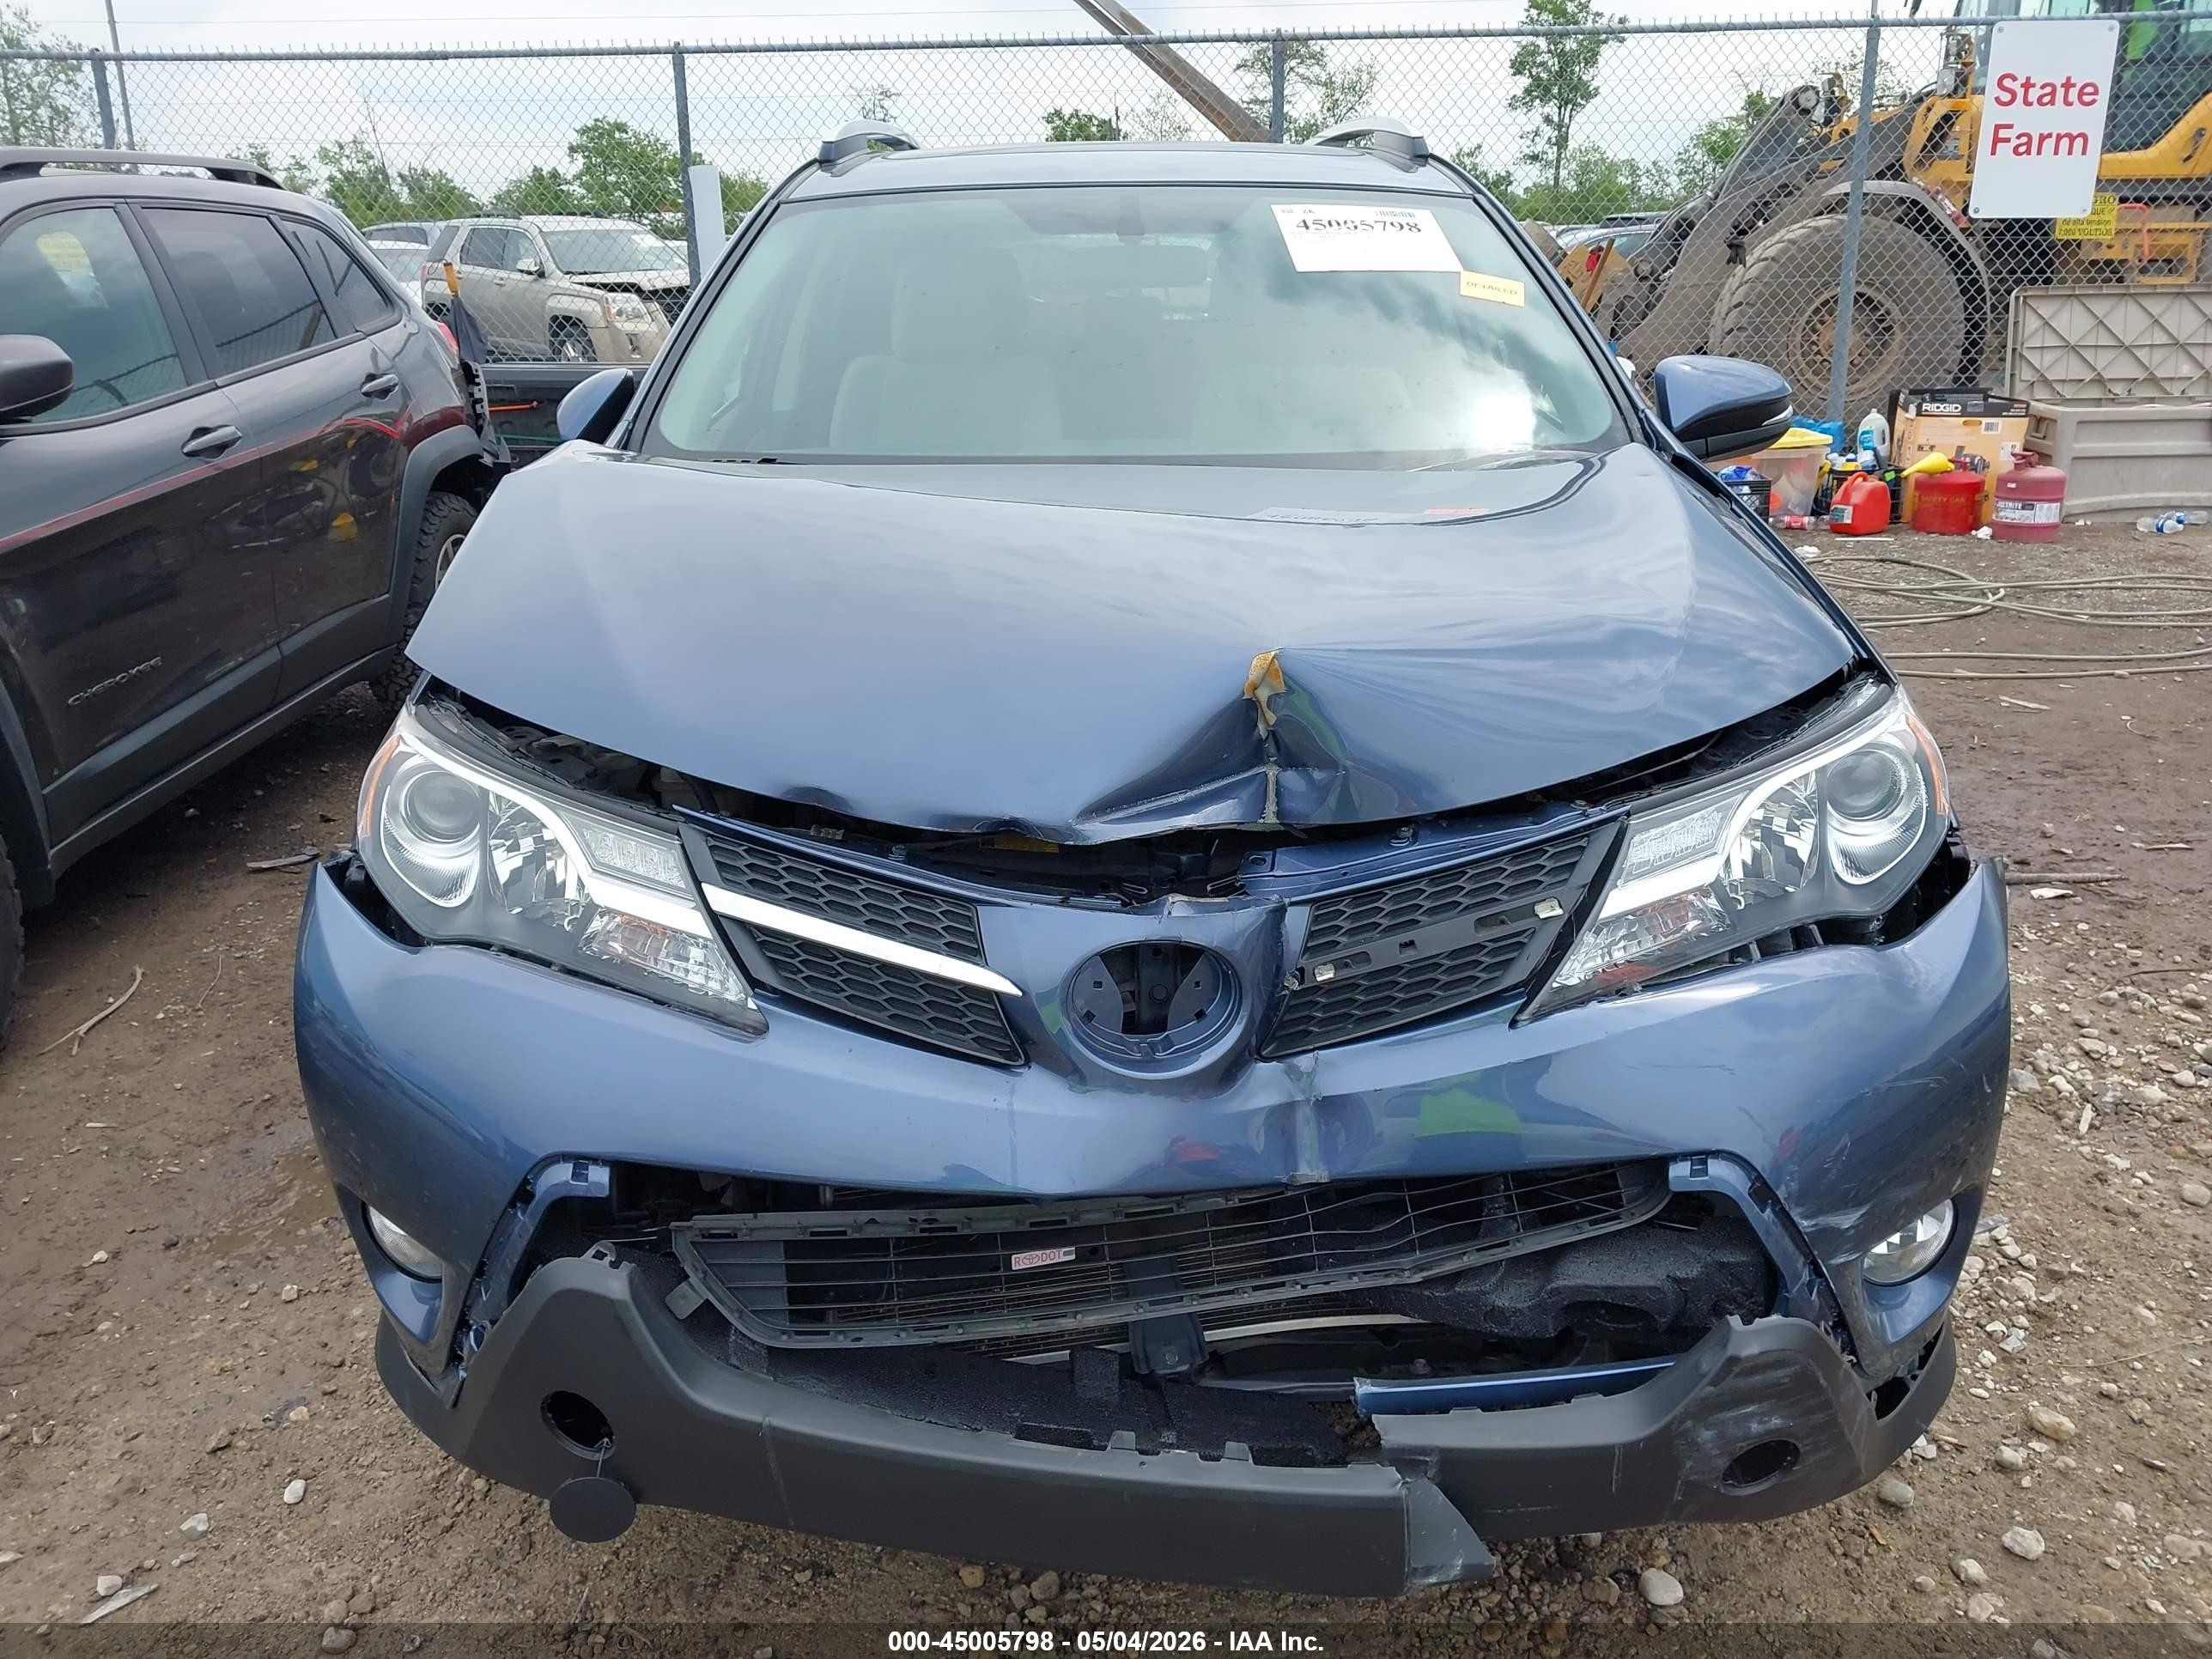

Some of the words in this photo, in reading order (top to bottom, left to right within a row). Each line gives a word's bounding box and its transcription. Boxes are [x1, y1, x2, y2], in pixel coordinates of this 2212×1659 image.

[1994, 72, 2100, 107] State
[1989, 123, 2089, 157] Farm
[1921, 403, 1962, 412] RIDGID
[67, 656, 163, 707] CHEROKEE
